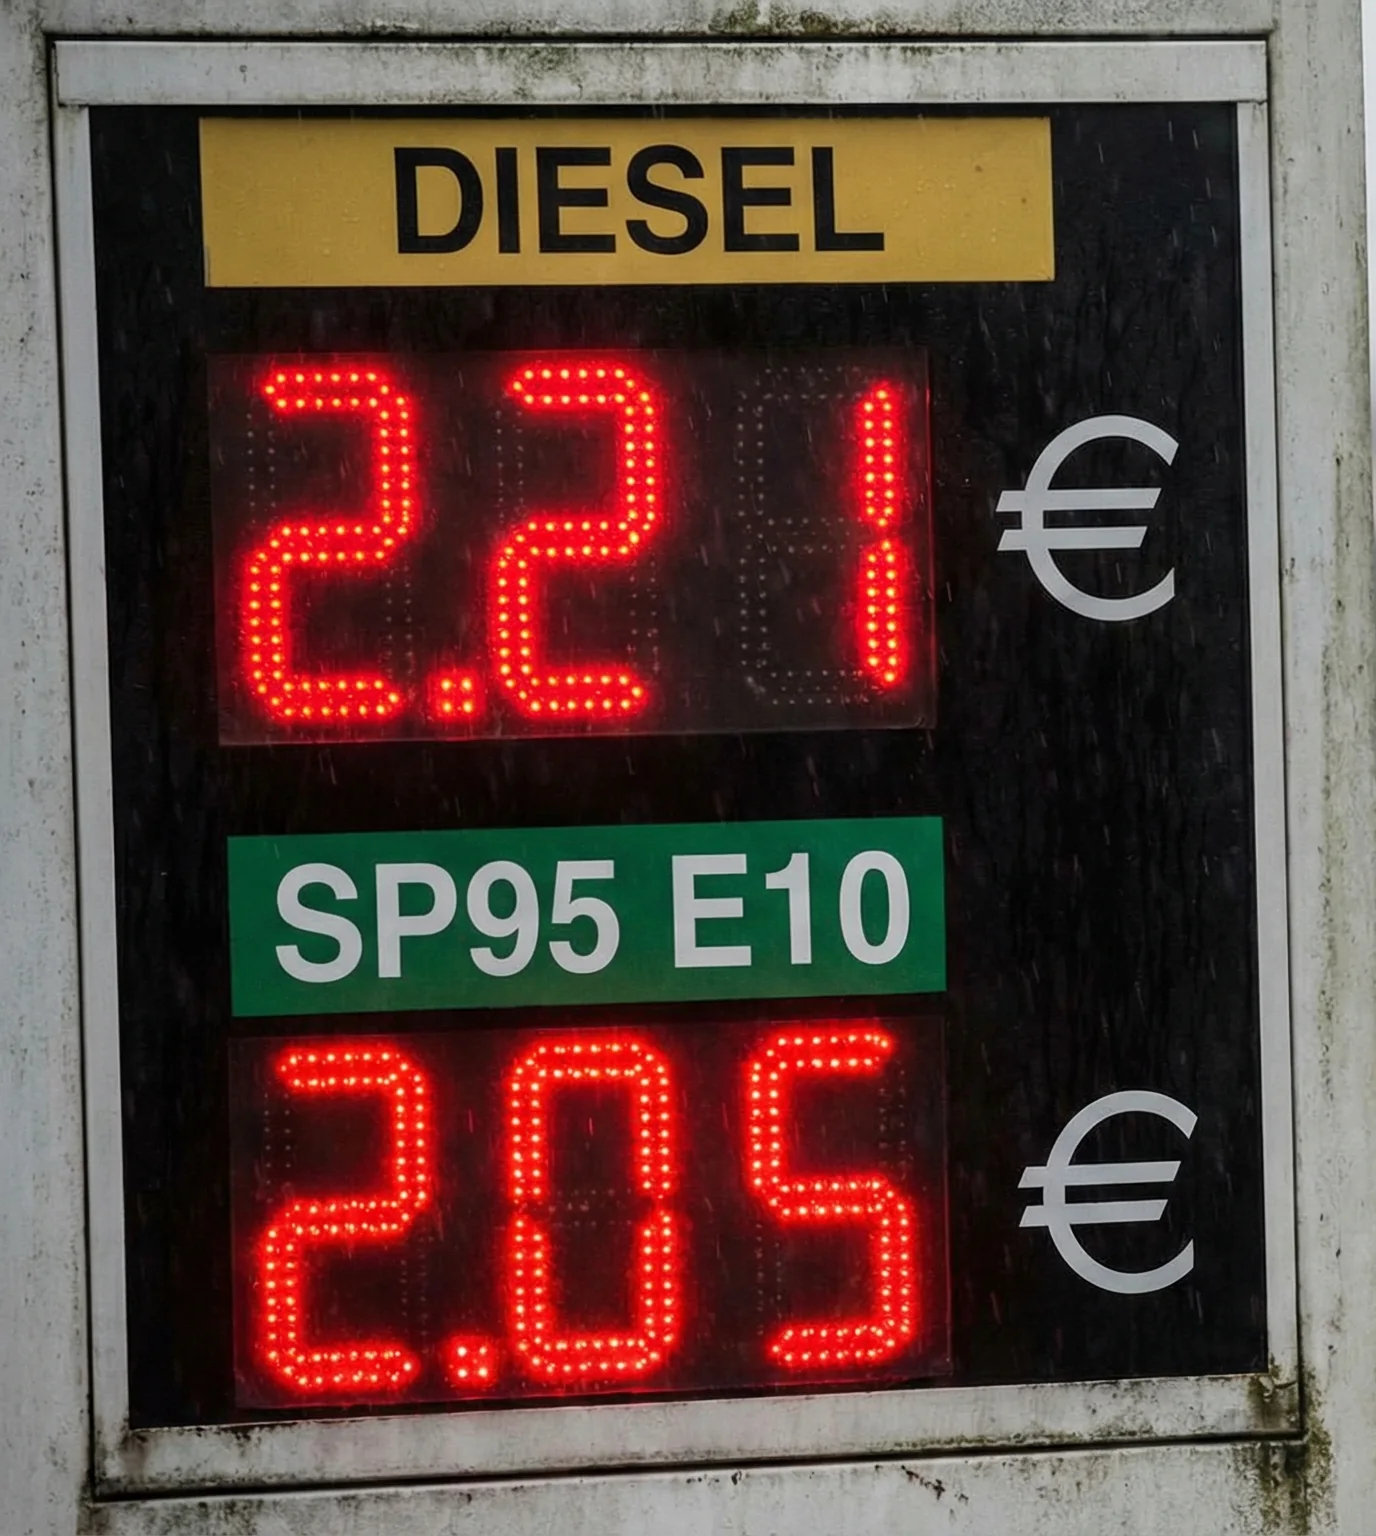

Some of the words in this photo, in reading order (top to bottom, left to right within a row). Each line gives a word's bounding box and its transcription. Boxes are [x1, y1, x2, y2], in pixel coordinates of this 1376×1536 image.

[393, 144, 884, 255] DIESEL
[241, 360, 907, 721] 2.21
[996, 415, 1178, 621] €
[275, 859, 620, 983] SP95
[672, 850, 911, 969] E10
[256, 1030, 917, 1391] 2.05
[1018, 1090, 1197, 1294] €
